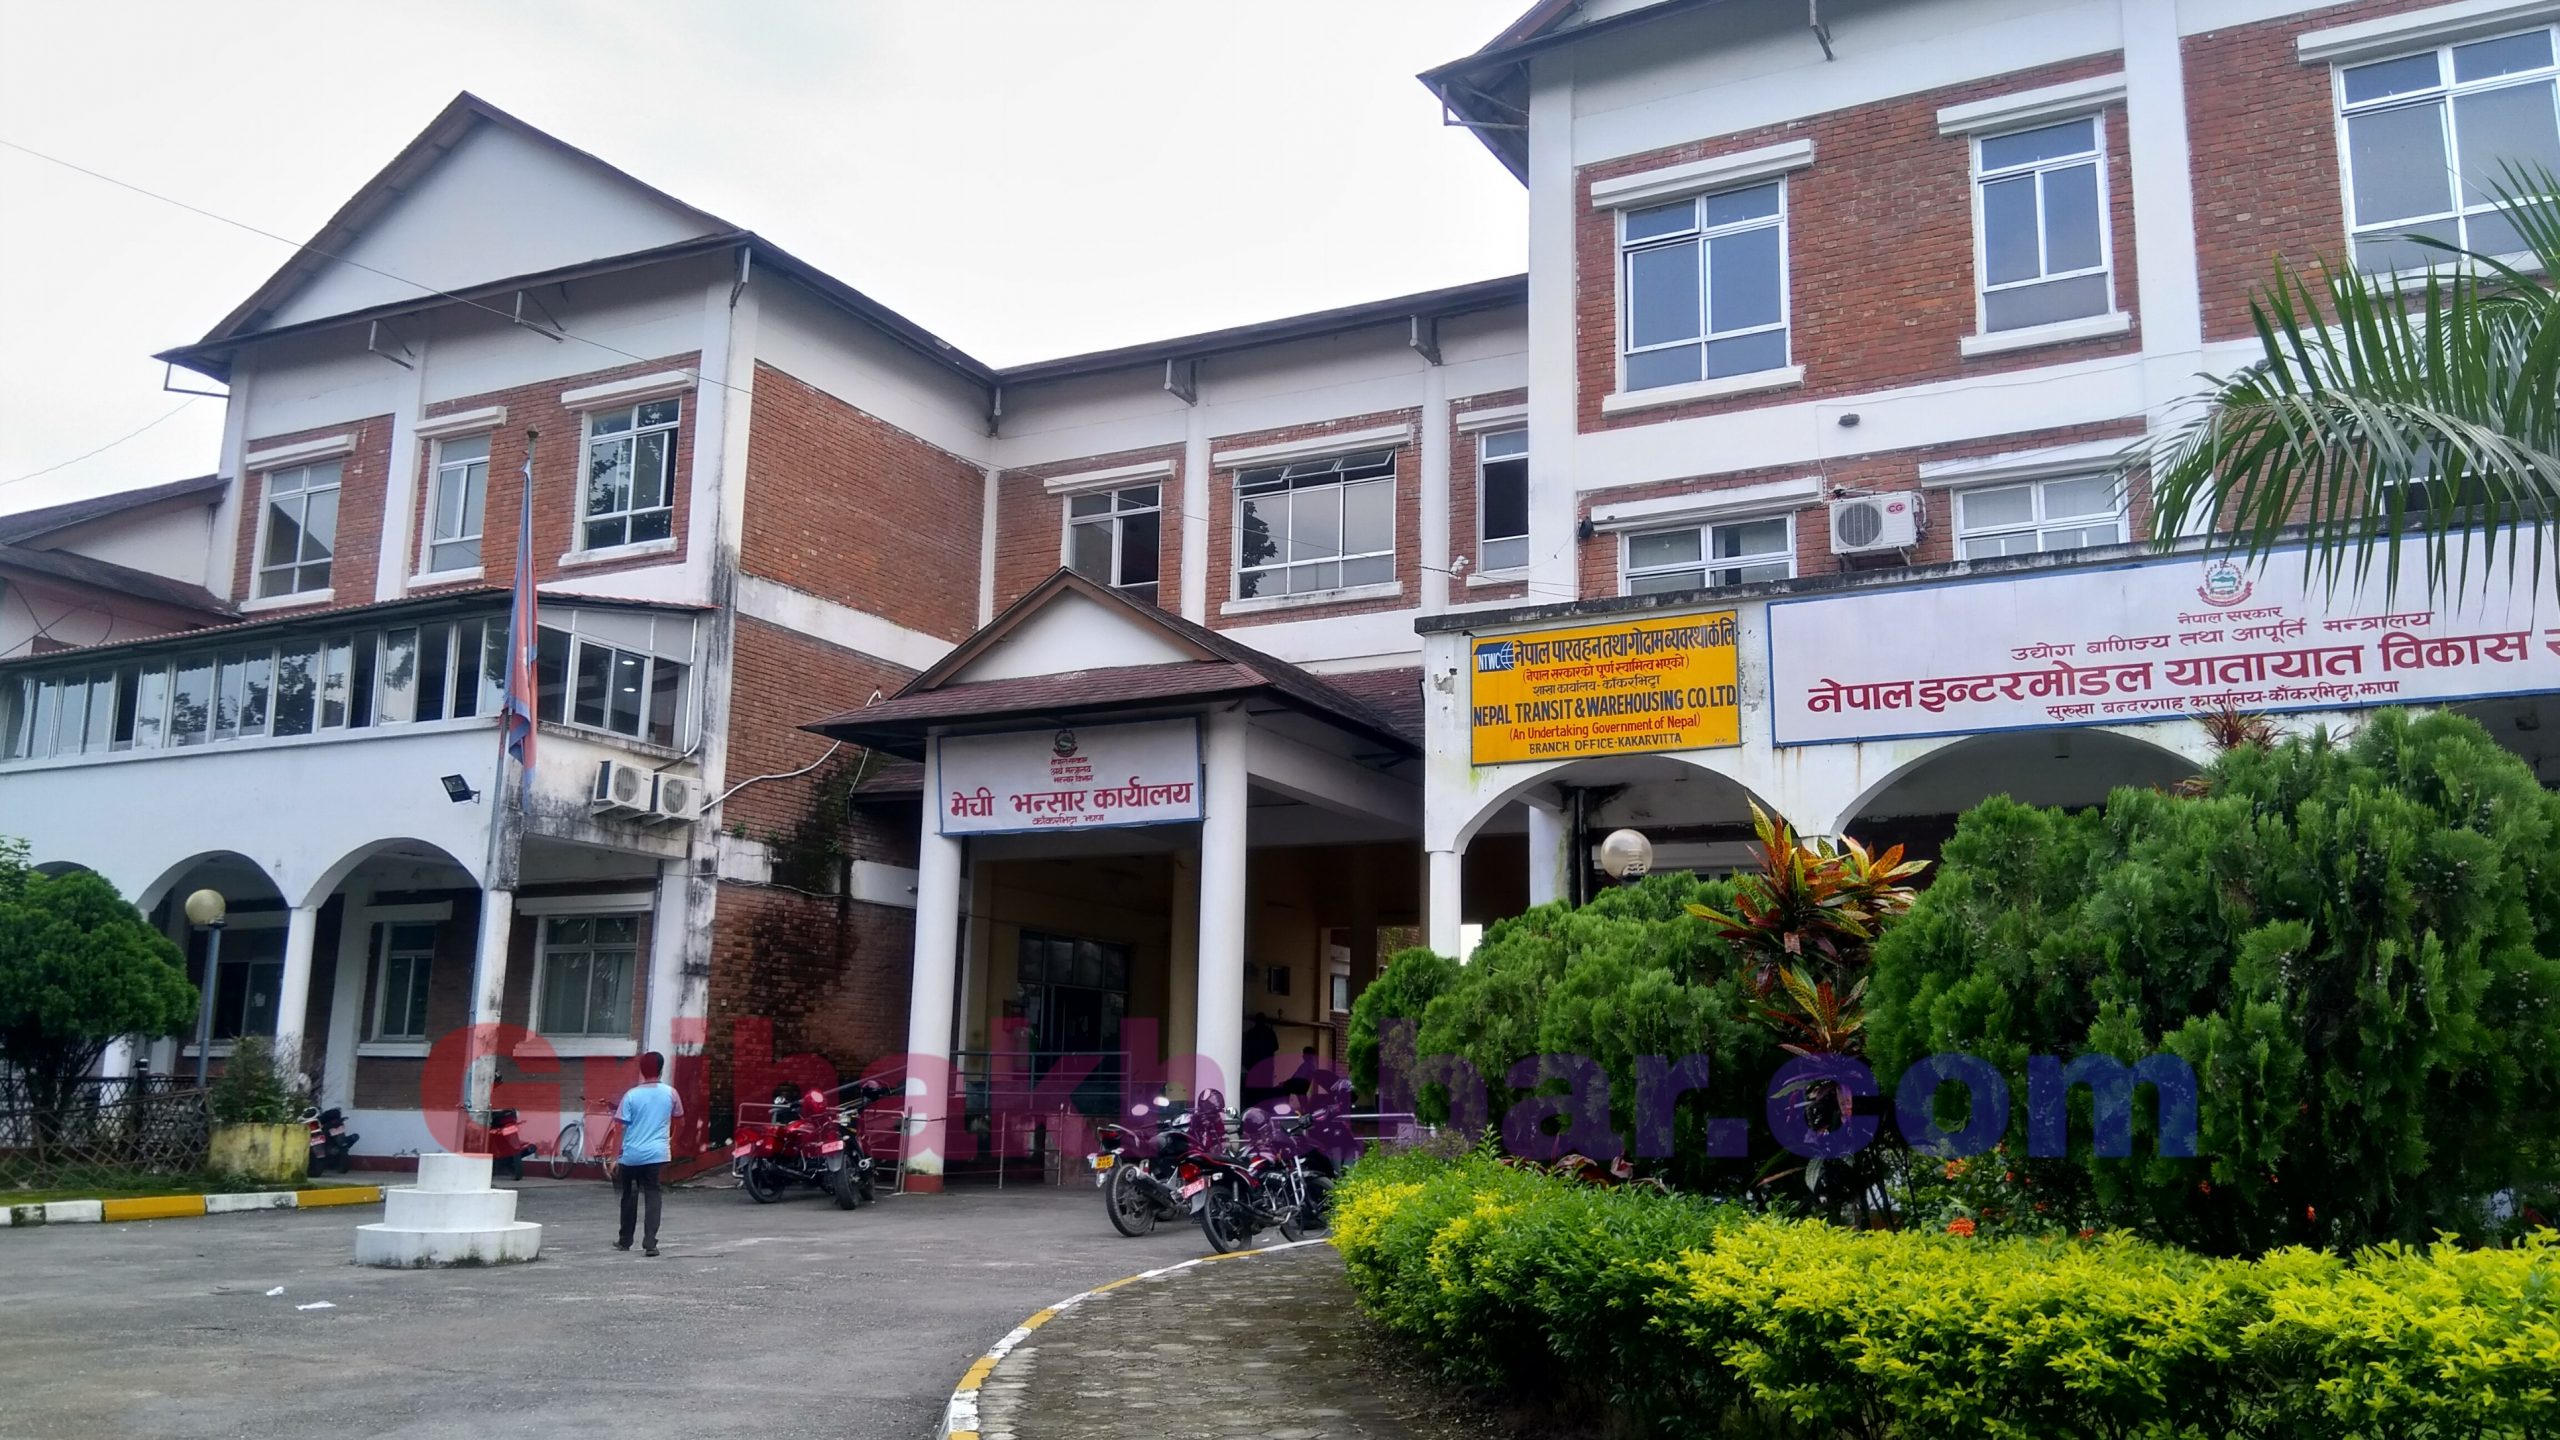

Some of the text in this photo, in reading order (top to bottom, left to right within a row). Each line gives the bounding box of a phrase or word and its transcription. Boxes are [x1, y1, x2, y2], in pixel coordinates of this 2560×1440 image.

[2177, 606, 2284, 624] नेपाल सरकार
[1514, 639, 1550, 667] नेपाल
[1552, 636, 1602, 662] पारवहन
[1602, 633, 1628, 658] तथा
[1628, 628, 1664, 655] गोदाम
[2011, 642, 2076, 661] उद्योग
[2179, 630, 2224, 646] तथा
[2231, 617, 2307, 643] आपूर्ति
[2323, 611, 2435, 632] मन्त्रालय
[1478, 652, 1501, 671] NTWC
[1550, 662, 1594, 680] सरकारको
[1807, 678, 1914, 713] नेपाल
[1918, 660, 2153, 713] इन्टरमोडल
[2165, 645, 2364, 686] यातायात
[2378, 631, 2531, 672] विकास
[1473, 704, 1512, 727] NEPAL
[1515, 698, 1573, 724] TRANSIT
[1586, 688, 1684, 717] WAREHOUSING
[2101, 697, 2185, 714] बन्दरगाह
[1509, 711, 1701, 741] (An Undertaking Government of Nepal)
[1529, 741, 1570, 754] BRANCH
[950, 775, 1194, 818] मेची भन्सार कार्यालय
